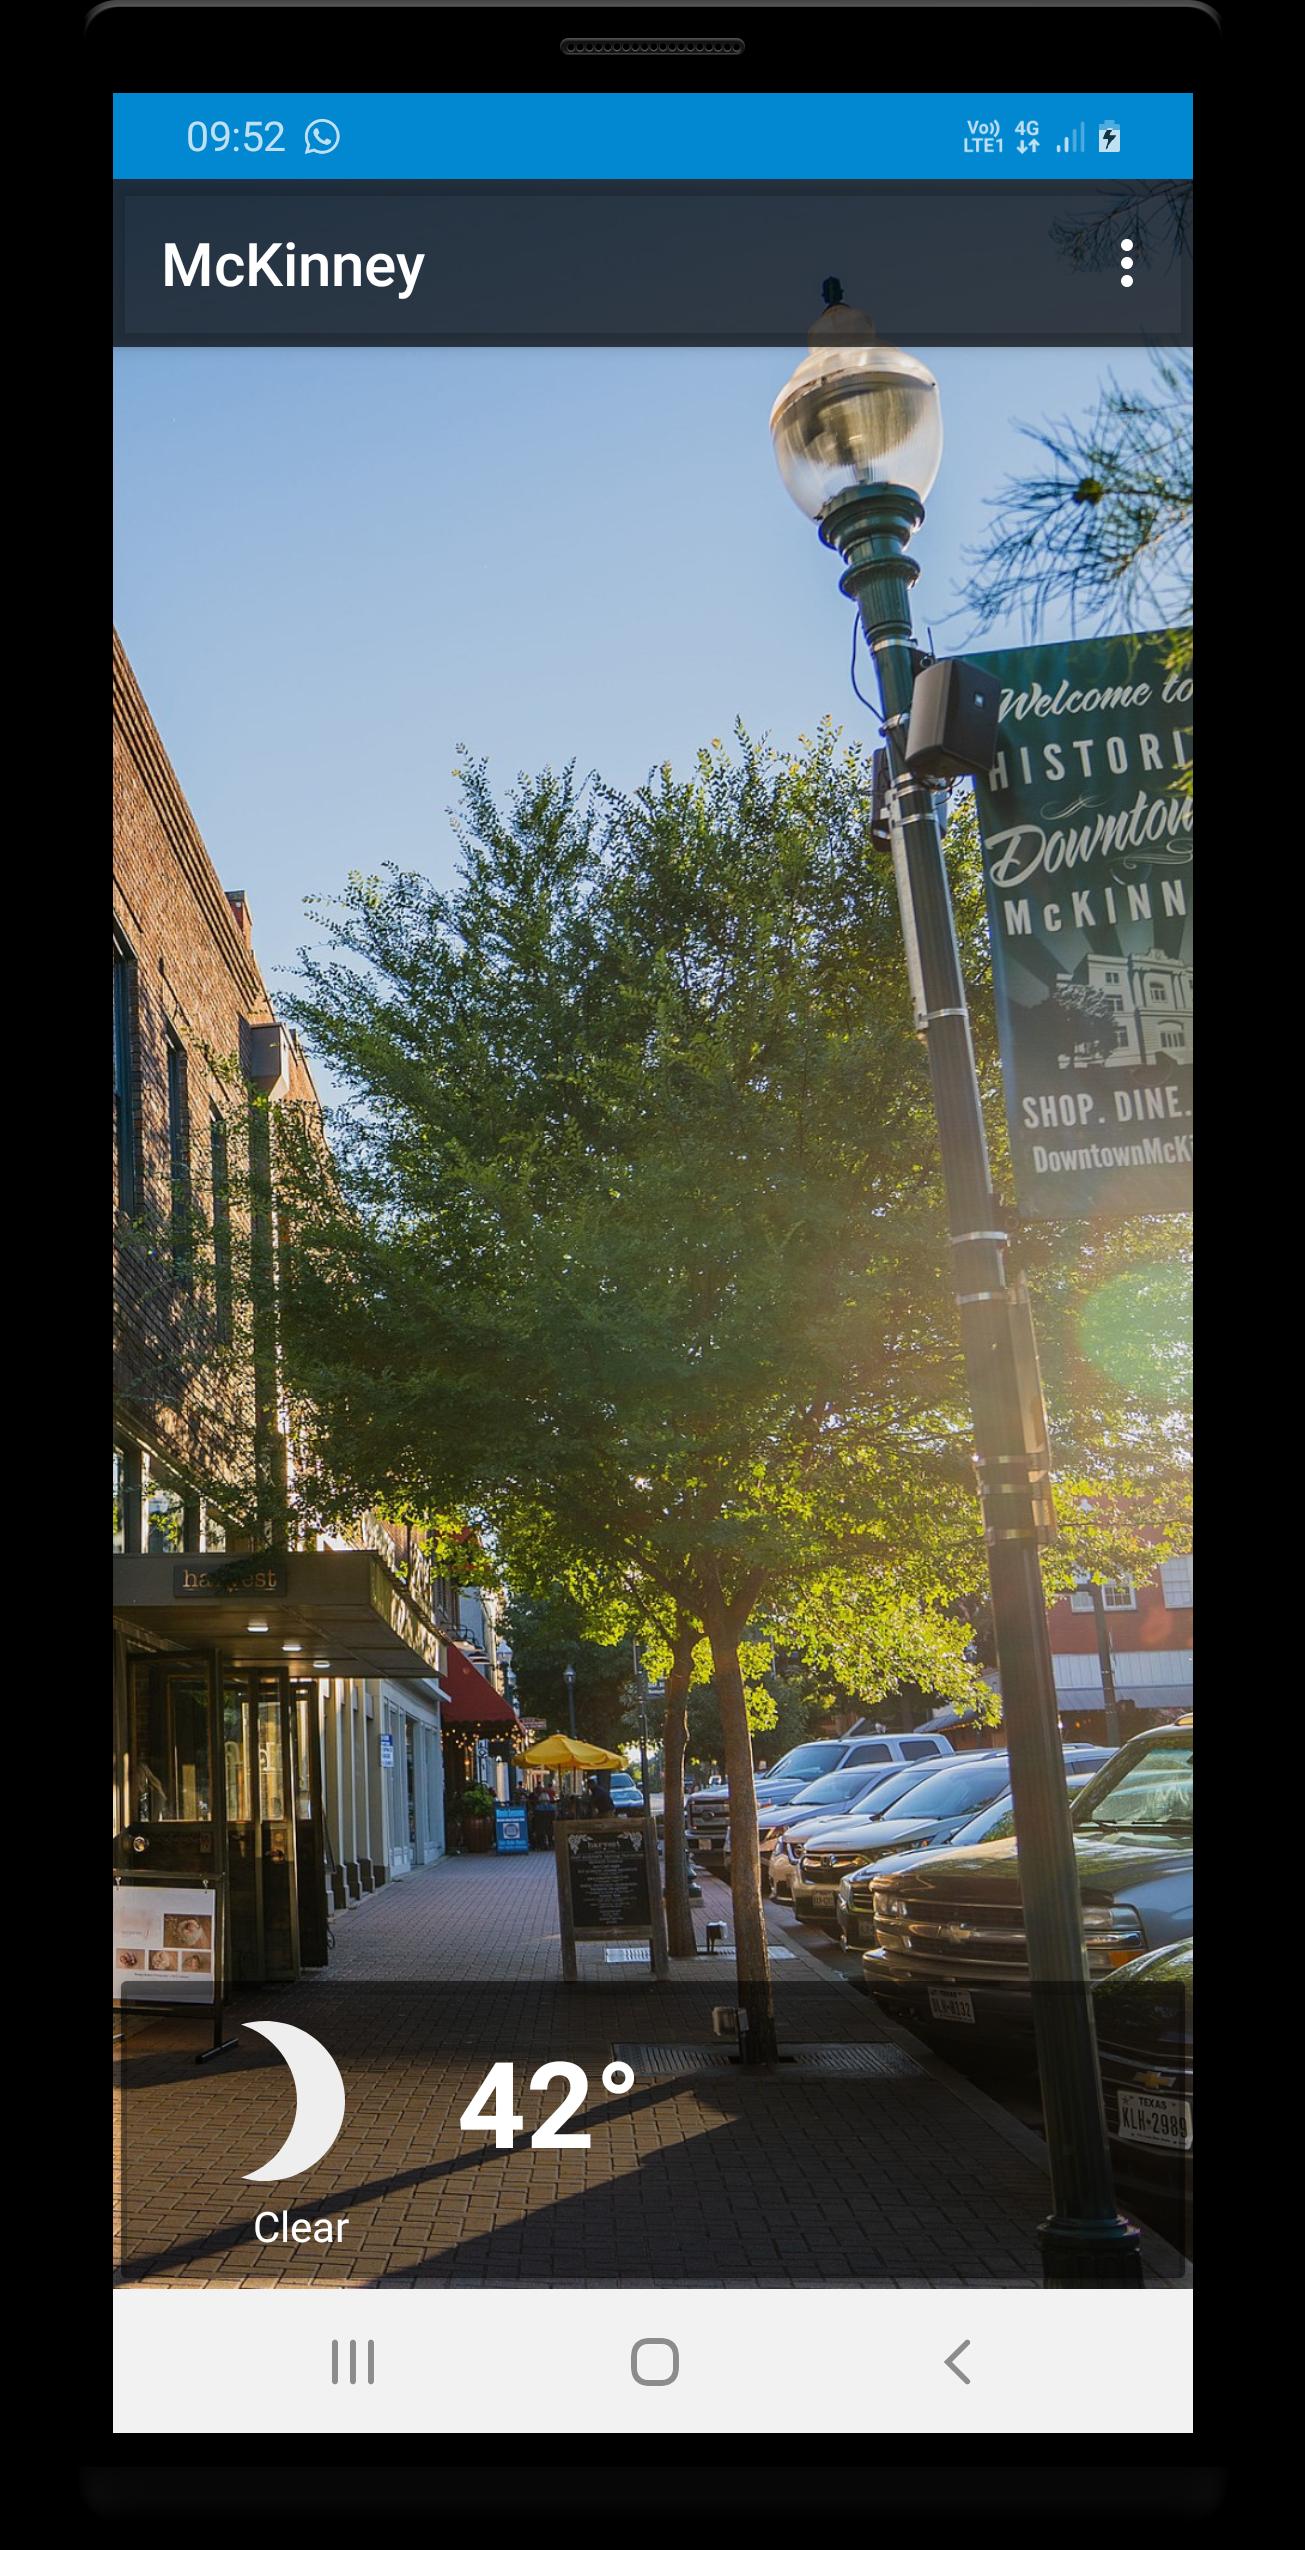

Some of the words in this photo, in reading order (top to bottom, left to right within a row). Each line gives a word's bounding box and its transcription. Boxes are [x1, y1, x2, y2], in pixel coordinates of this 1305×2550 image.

[187, 120, 286, 153] 09:52
[1014, 120, 1040, 136] 4G
[963, 138, 1003, 153] LTE1
[163, 241, 426, 300] McKinney
[998, 679, 1152, 723] Welcome
[1161, 670, 1193, 703] to
[182, 1568, 278, 1589] haest
[459, 2060, 636, 2150] 42°
[1138, 2096, 1168, 2110] TEXAS
[254, 2211, 351, 2244] Clear
